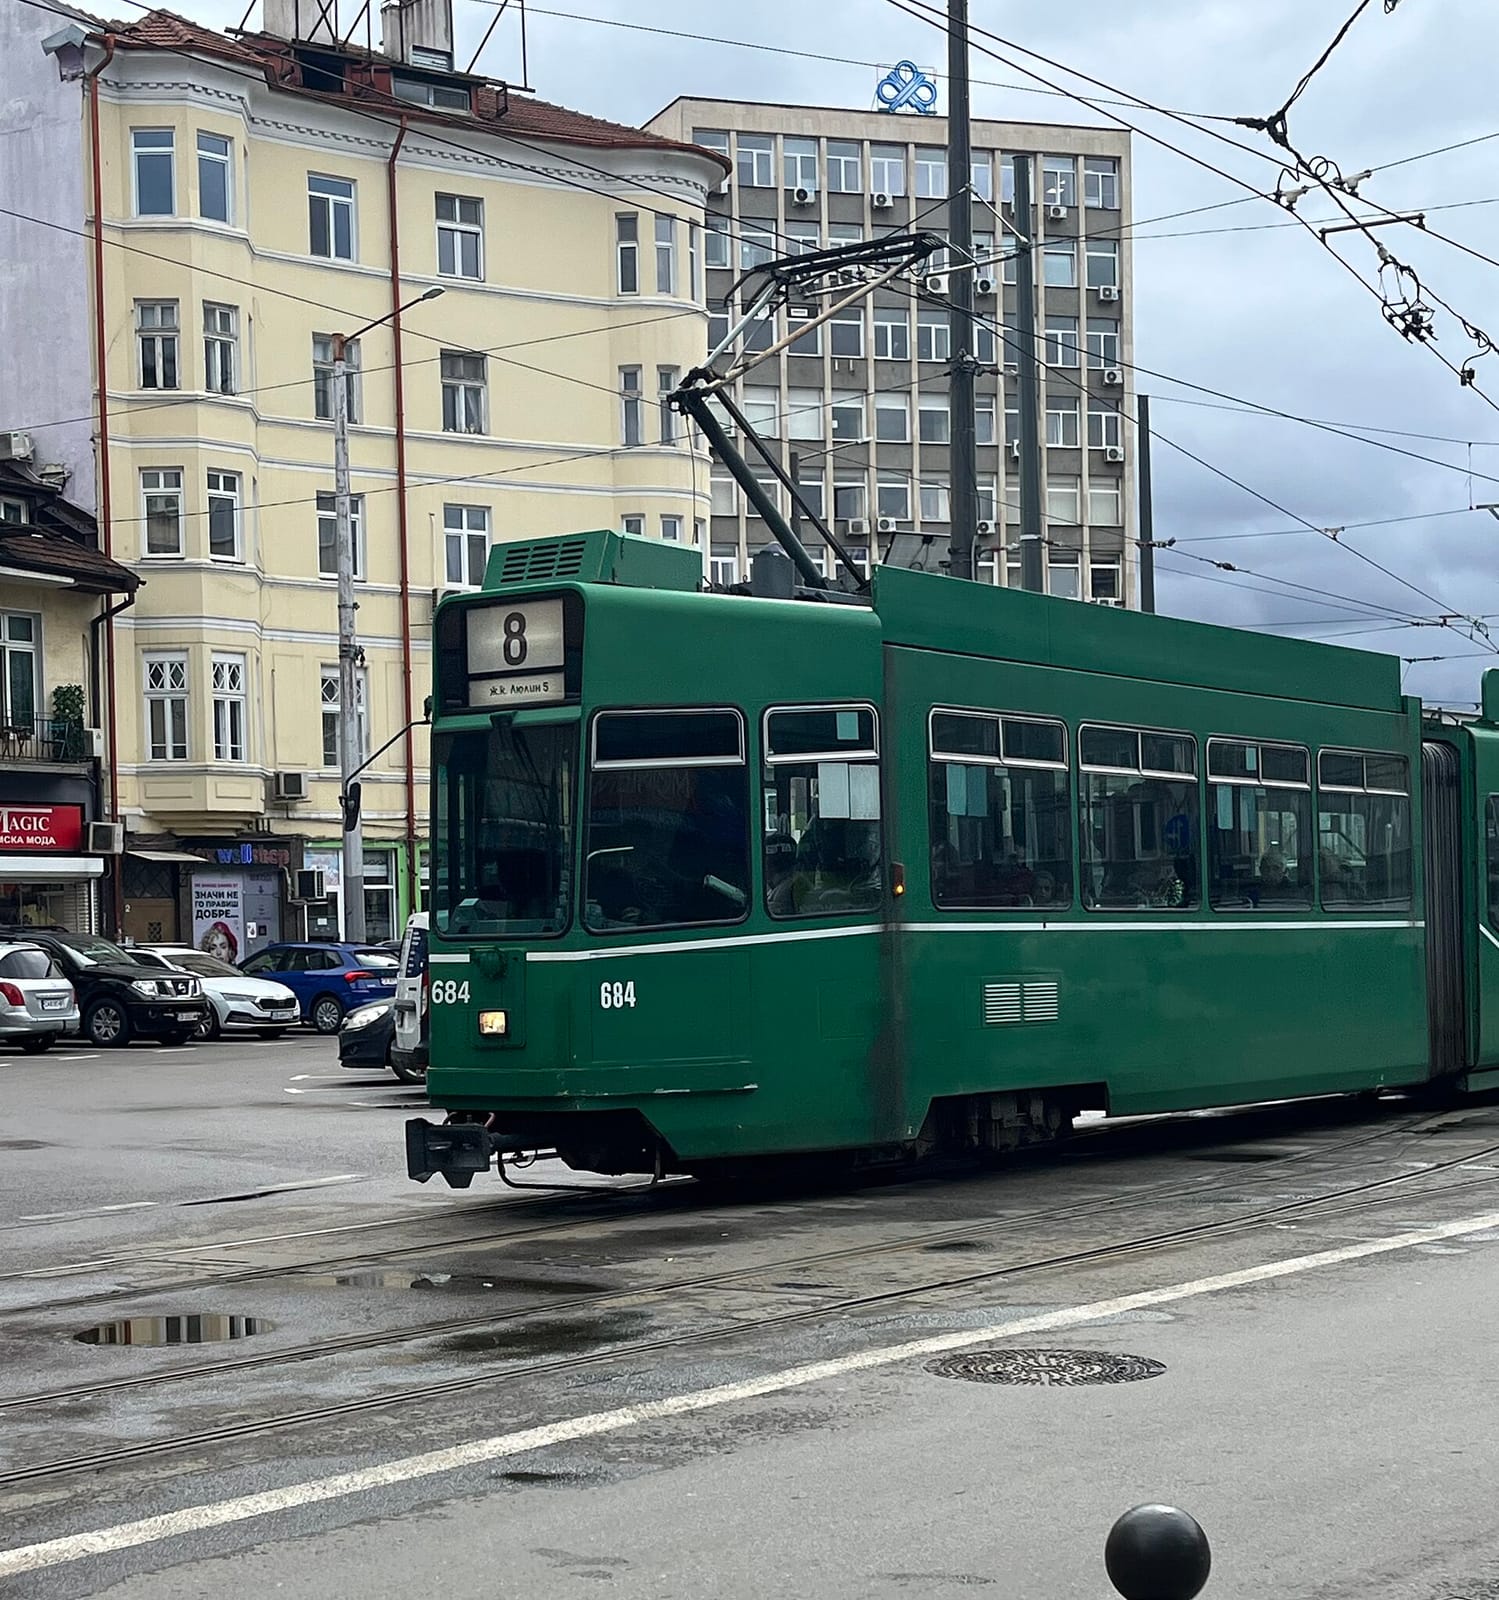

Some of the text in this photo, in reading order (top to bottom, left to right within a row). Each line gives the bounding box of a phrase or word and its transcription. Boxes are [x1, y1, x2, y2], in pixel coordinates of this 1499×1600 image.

[503, 612, 527, 666] 8
[543, 682, 549, 692] 5
[26, 836, 56, 846] МОДА
[194, 891, 239, 899] ЗНАЧИ НЕ
[194, 900, 239, 908] ГО ПРАВИШ
[431, 980, 471, 1004] 684
[600, 981, 637, 1009] 684
